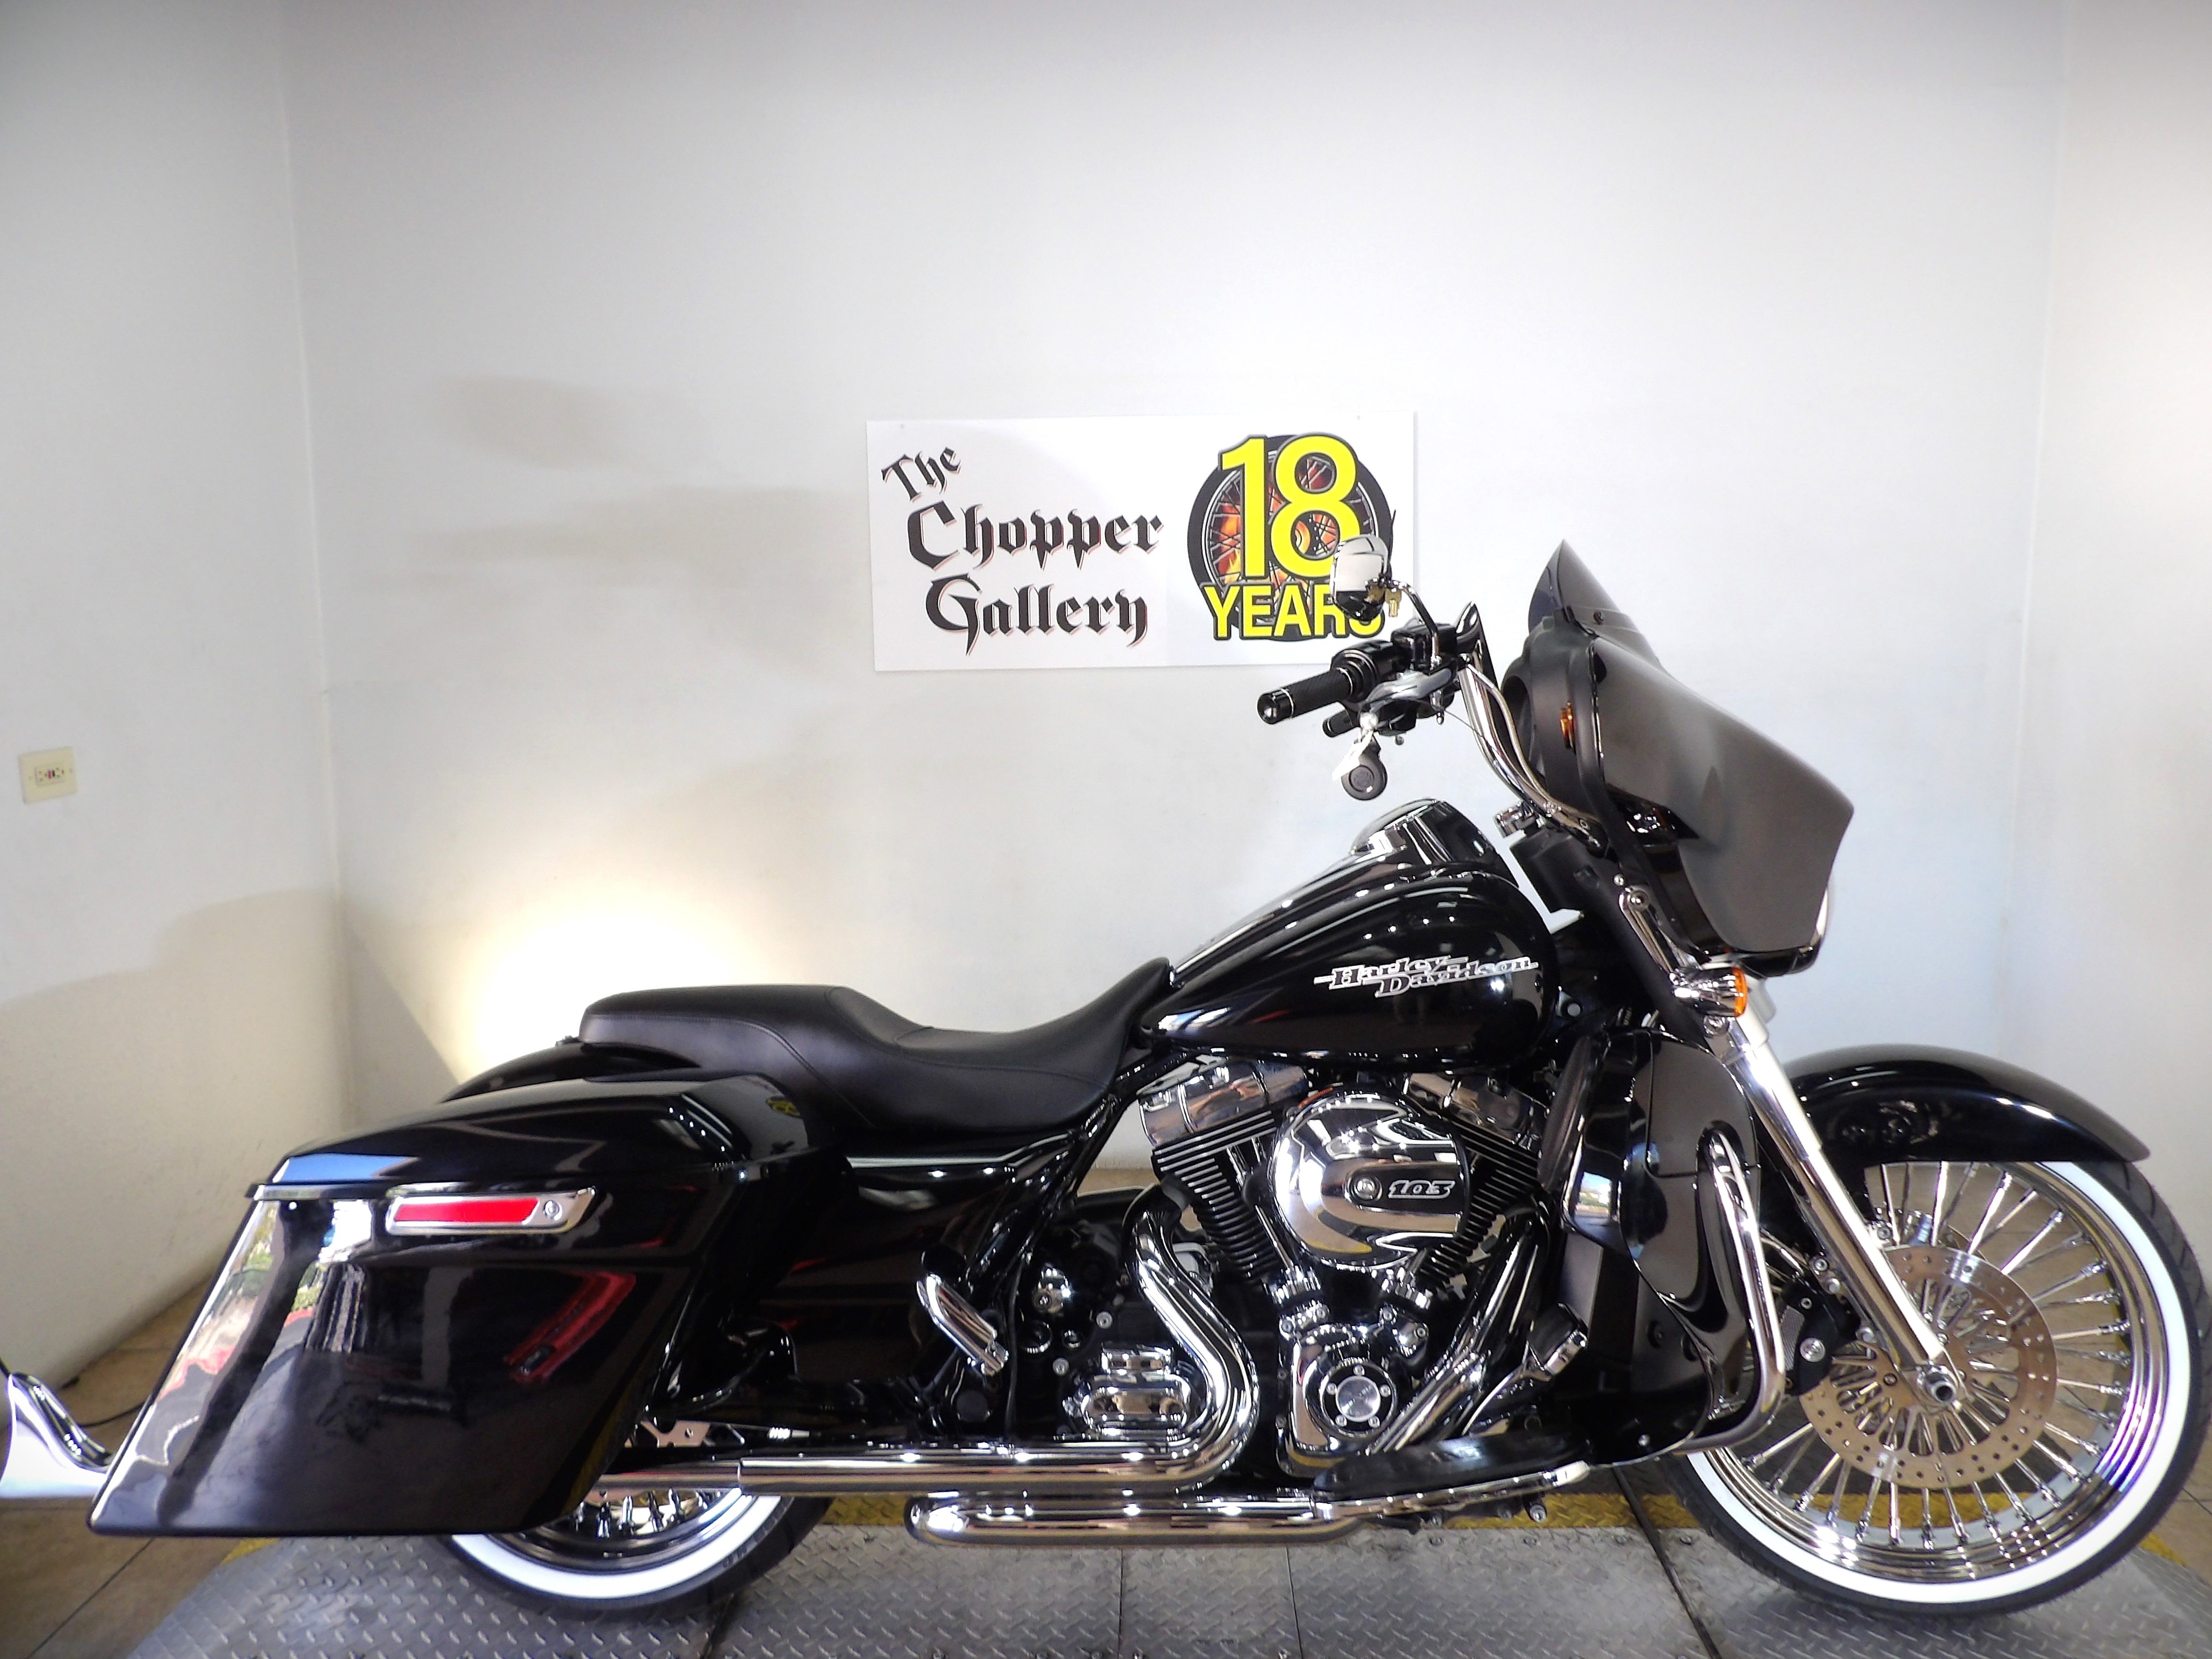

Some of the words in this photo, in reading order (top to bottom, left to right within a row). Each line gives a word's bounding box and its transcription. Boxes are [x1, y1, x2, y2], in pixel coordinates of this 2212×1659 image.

[881, 446, 961, 502] The
[1220, 433, 1361, 579] 18
[907, 500, 1163, 570] Chopper
[925, 572, 1148, 656] Gallery
